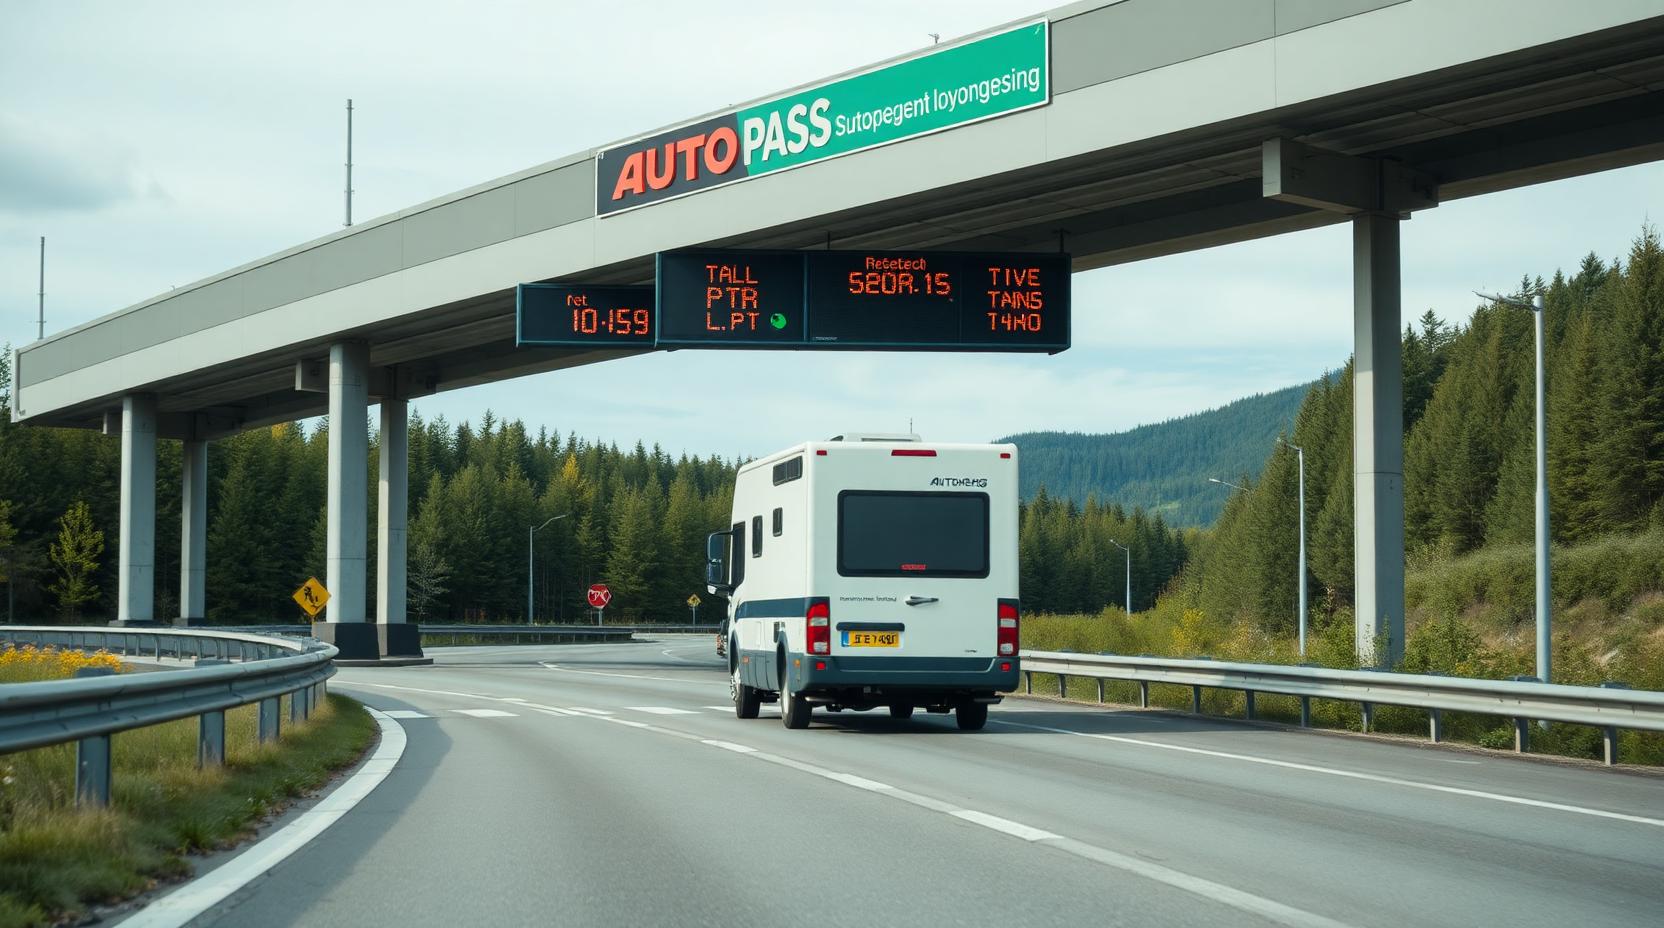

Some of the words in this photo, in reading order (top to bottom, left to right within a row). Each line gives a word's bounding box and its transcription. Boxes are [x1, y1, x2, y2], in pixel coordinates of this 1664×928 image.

[612, 127, 739, 200] AUTO
[743, 97, 831, 166] PASS
[835, 92, 930, 137] Sutopegent
[705, 264, 759, 284] TALL
[988, 267, 1041, 287] TIVE
[705, 287, 758, 309] PTR
